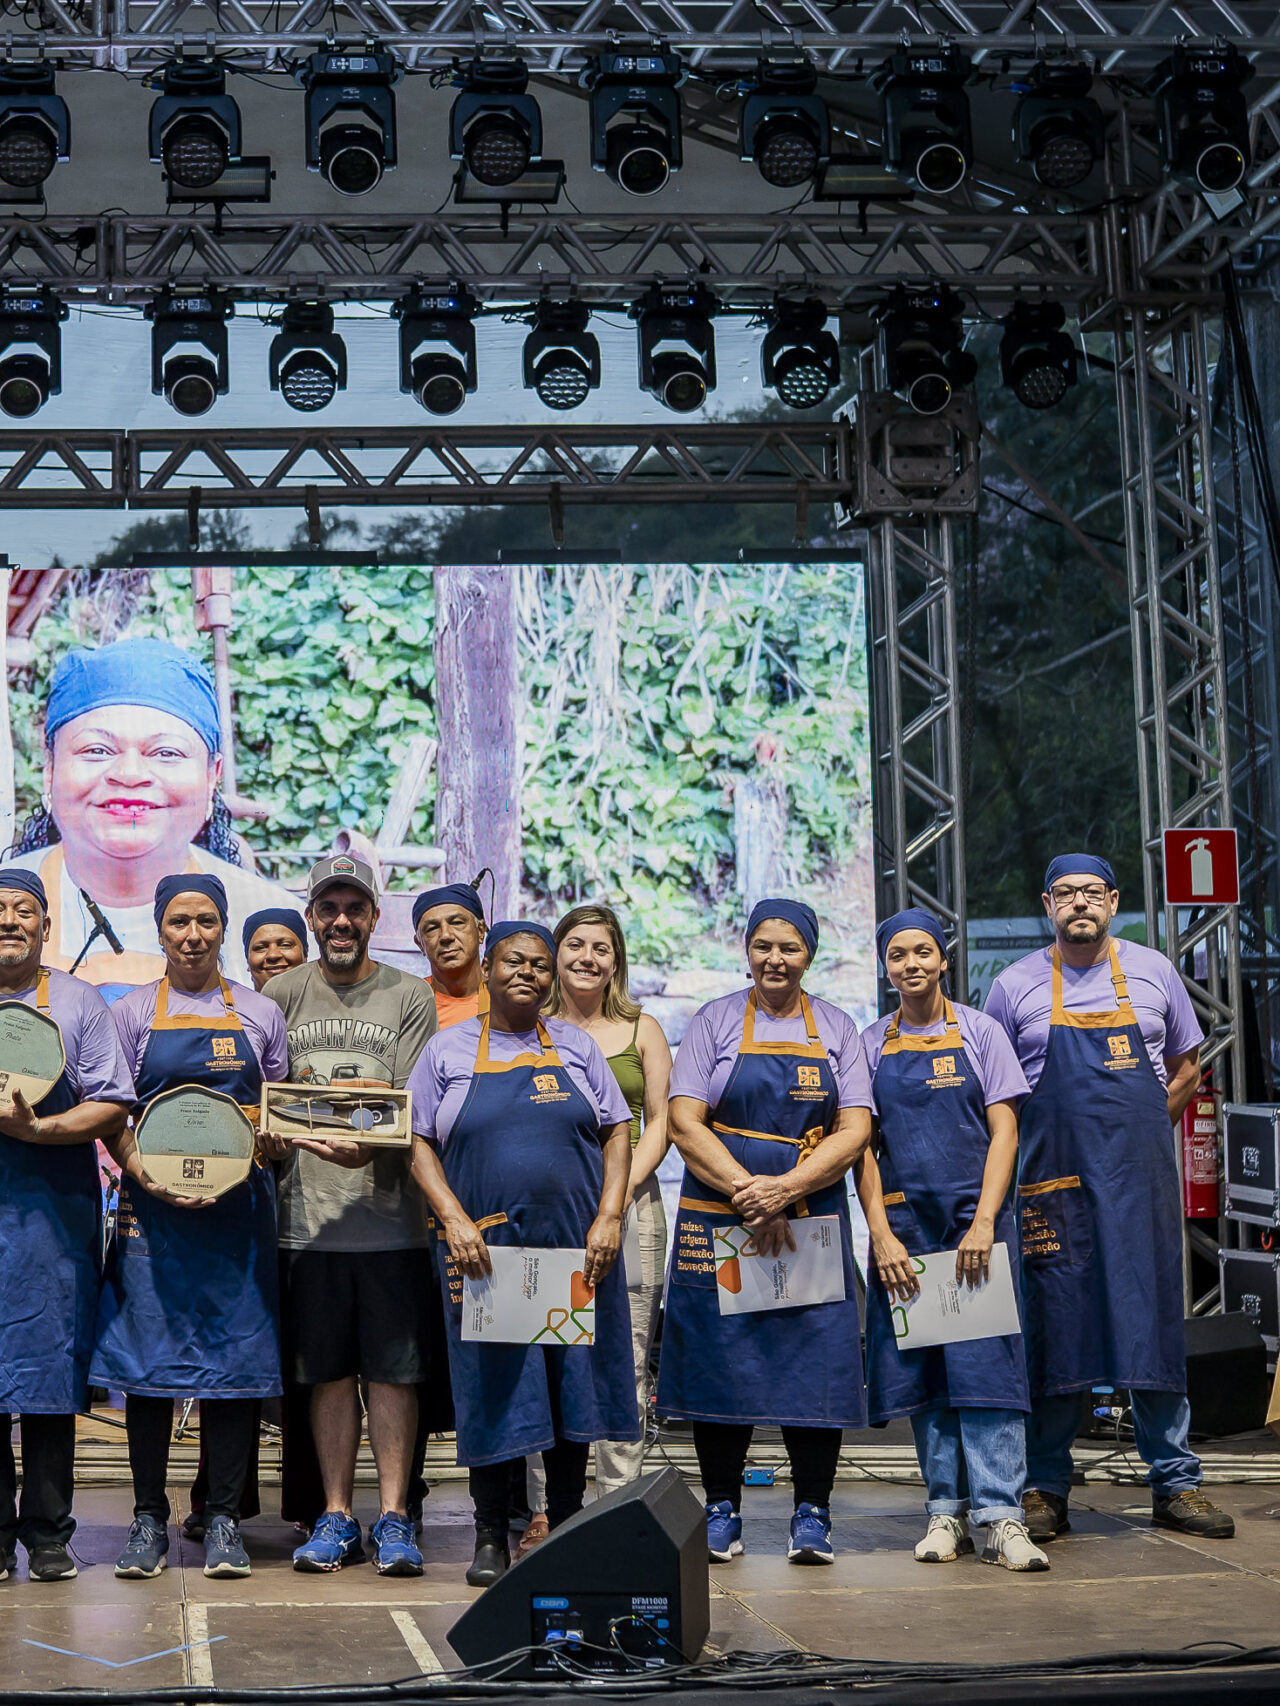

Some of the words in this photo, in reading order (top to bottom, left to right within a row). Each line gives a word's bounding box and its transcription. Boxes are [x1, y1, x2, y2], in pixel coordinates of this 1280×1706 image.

[287, 1019, 353, 1060] ROLLIN'
[350, 1020, 398, 1057] LOW
[680, 1221, 705, 1232] raízes
[680, 1234, 708, 1246] origem
[679, 1249, 714, 1259] conexão
[677, 1260, 716, 1274] inovação
